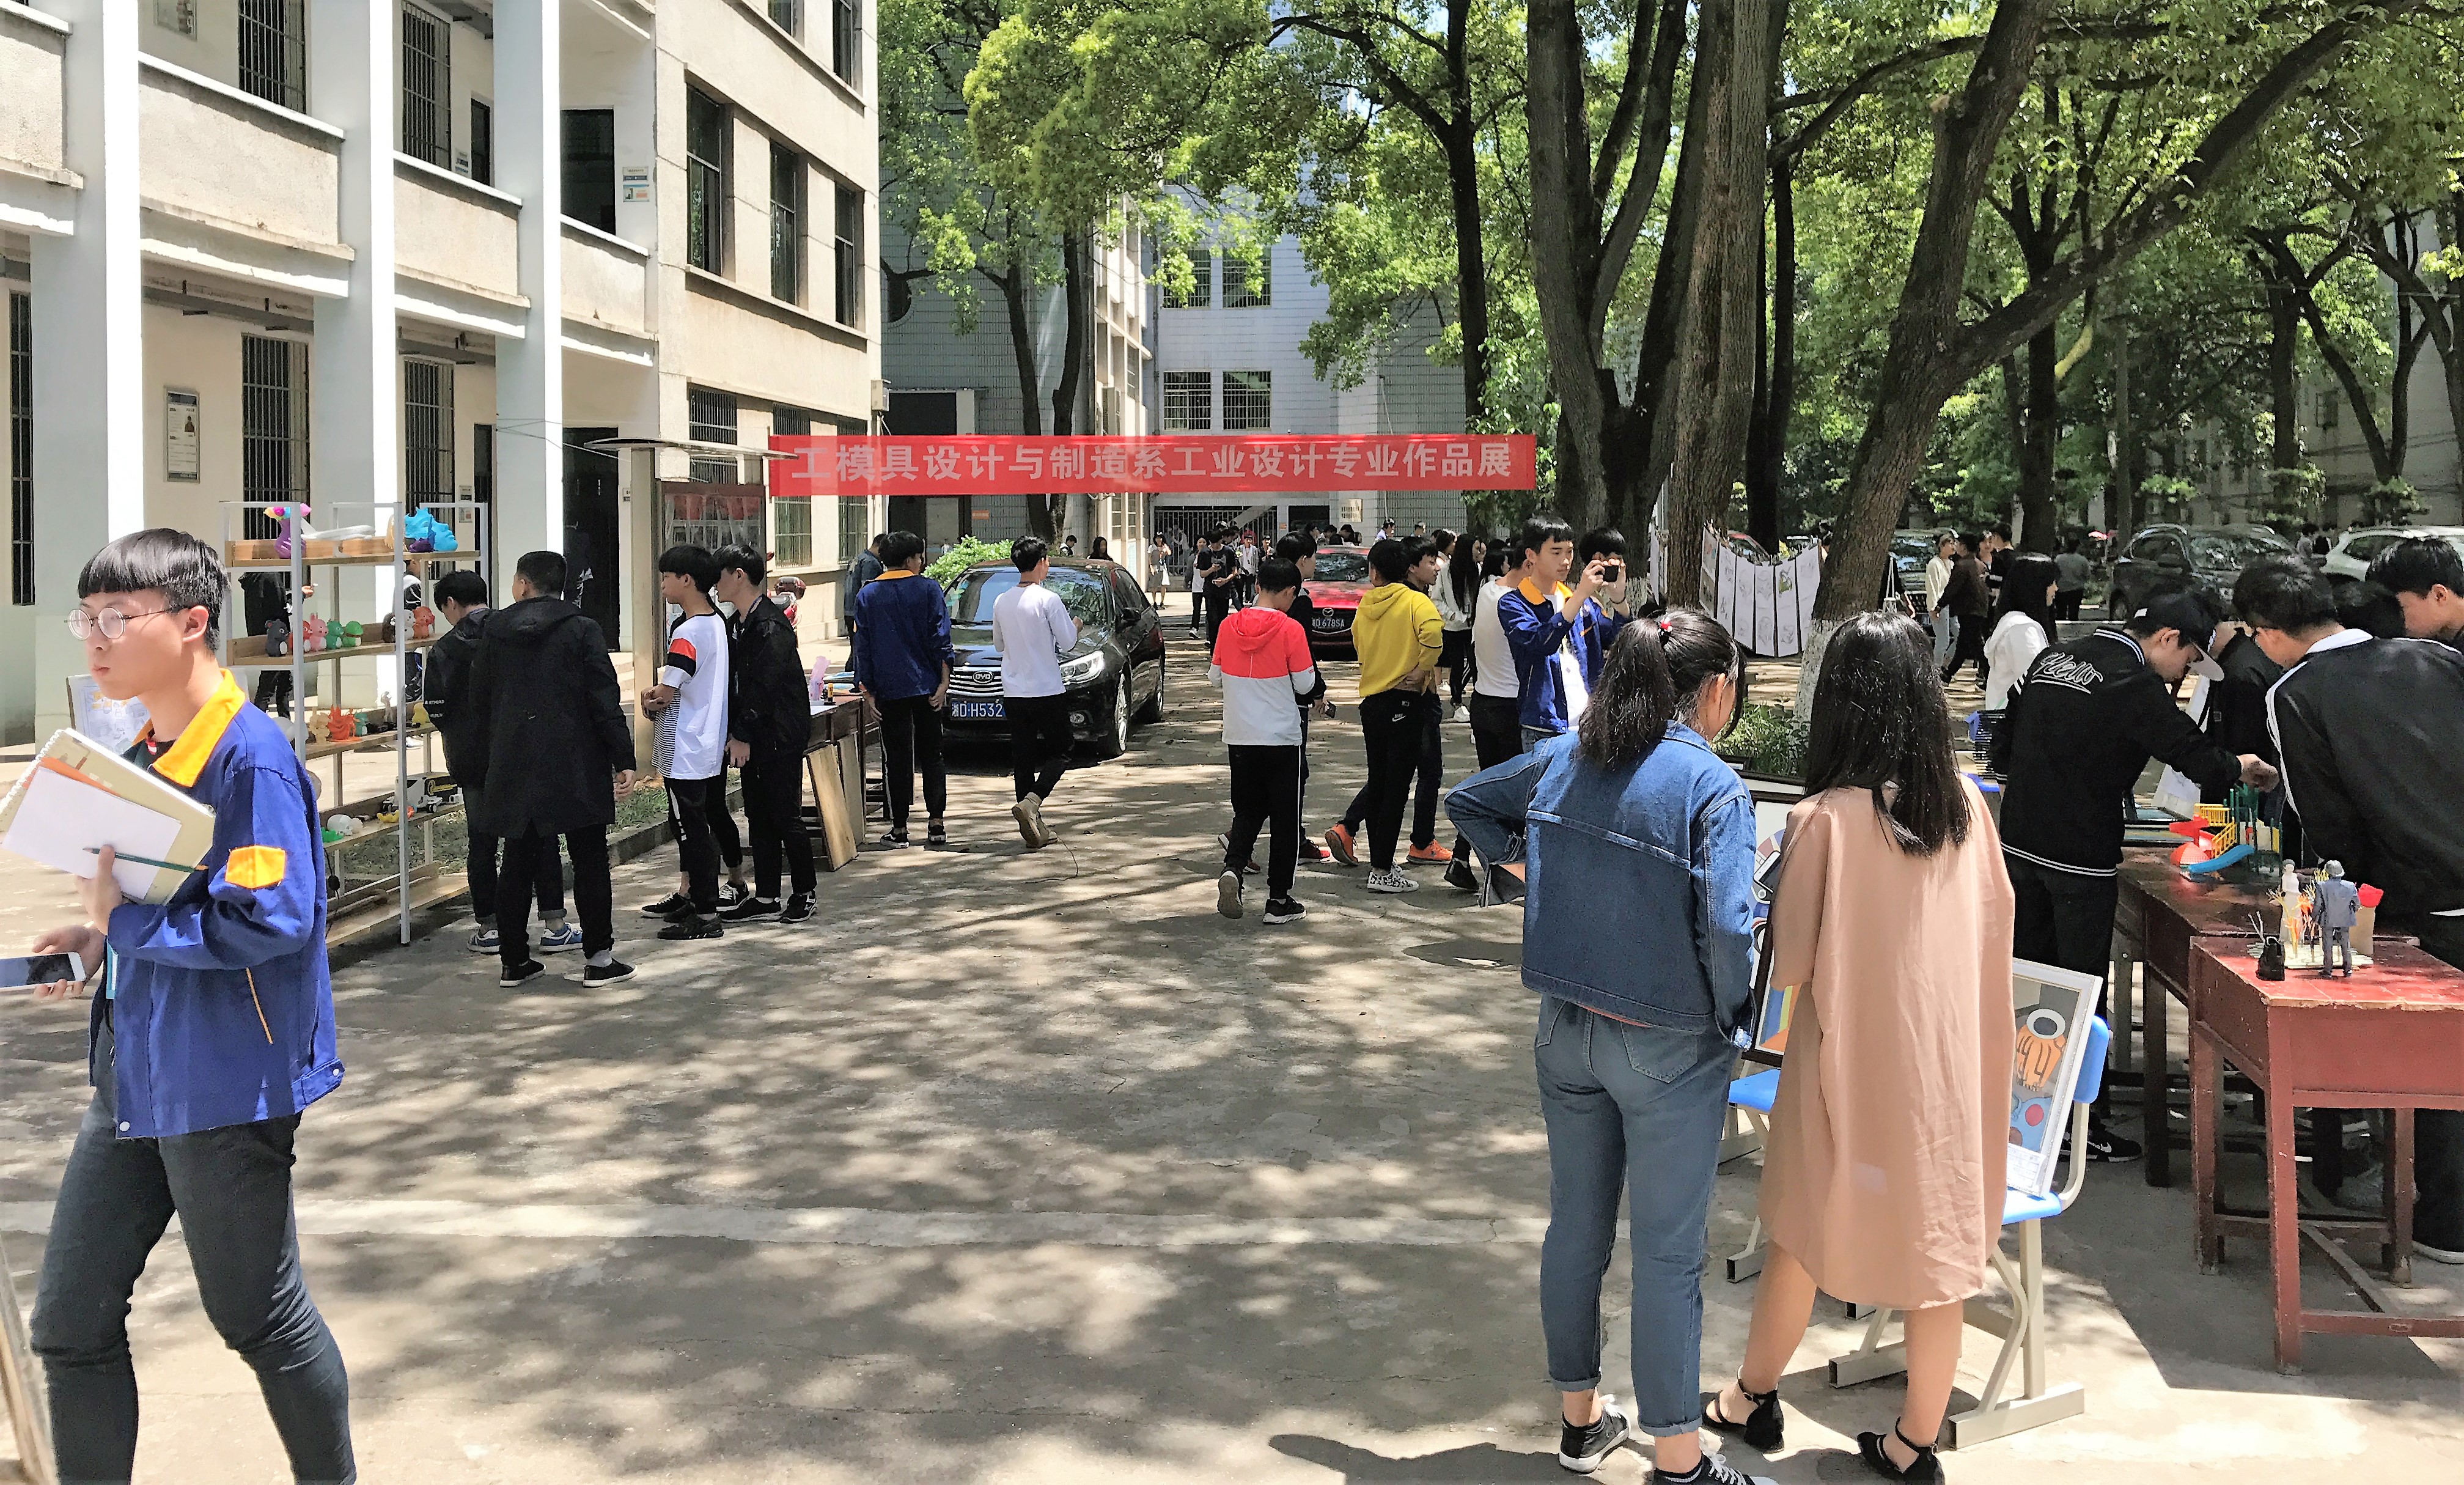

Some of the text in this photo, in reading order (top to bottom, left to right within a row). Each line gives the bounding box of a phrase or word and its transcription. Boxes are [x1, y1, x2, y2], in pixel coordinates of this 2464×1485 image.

[792, 442, 1512, 481] 工模具设计与制造系工业设计专业作品展
[2032, 652, 2103, 685] Hello
